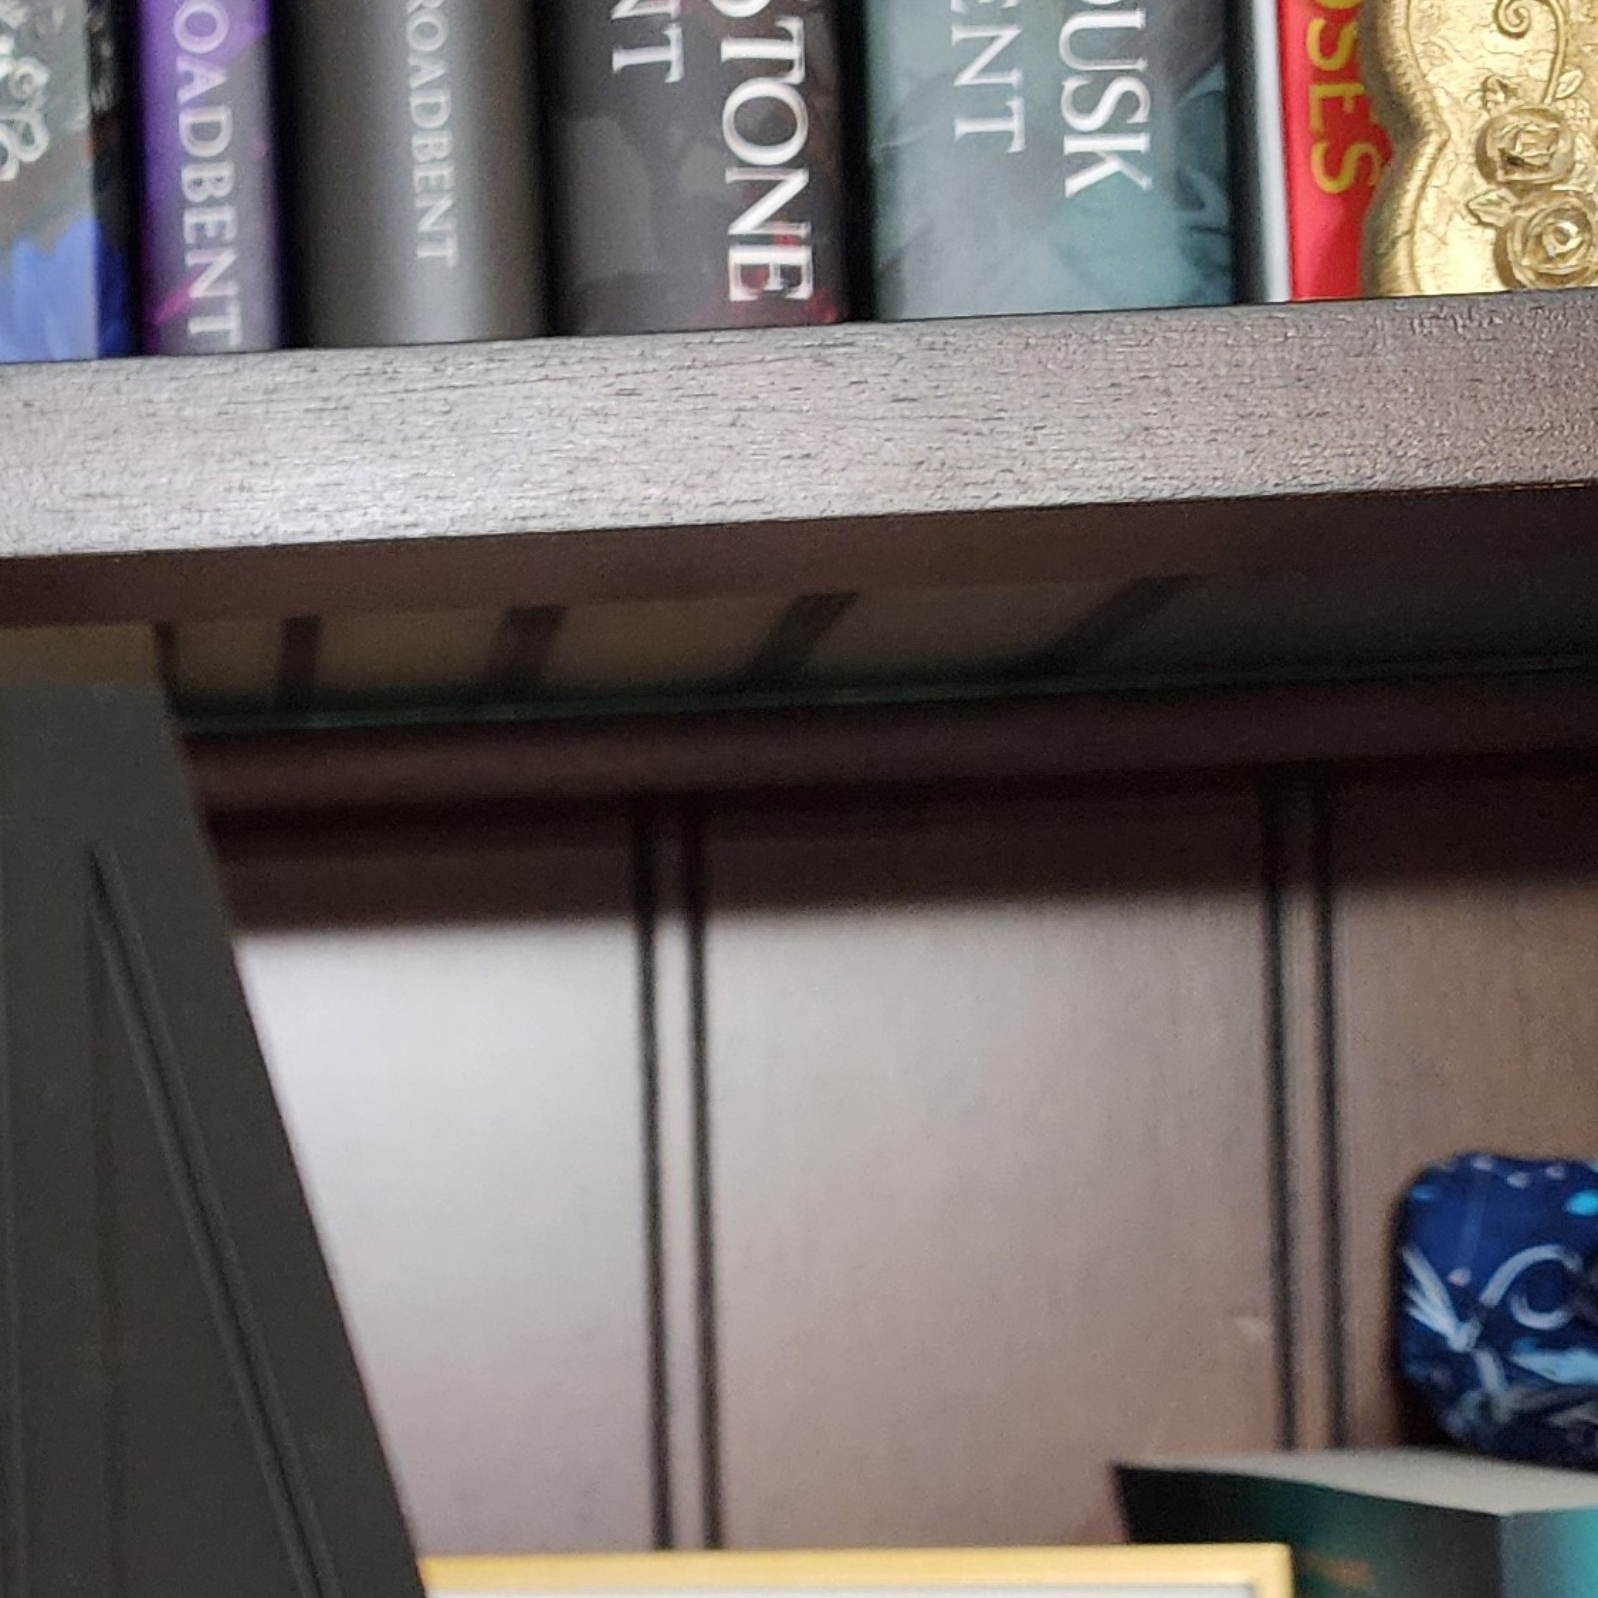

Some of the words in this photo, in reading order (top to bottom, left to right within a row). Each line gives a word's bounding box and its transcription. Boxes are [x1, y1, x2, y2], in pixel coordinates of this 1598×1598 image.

[406, 0, 459, 267] OADBENT
[950, 0, 1026, 153] NT
[1058, 0, 1153, 197] USK
[1306, 0, 1383, 194] SES
